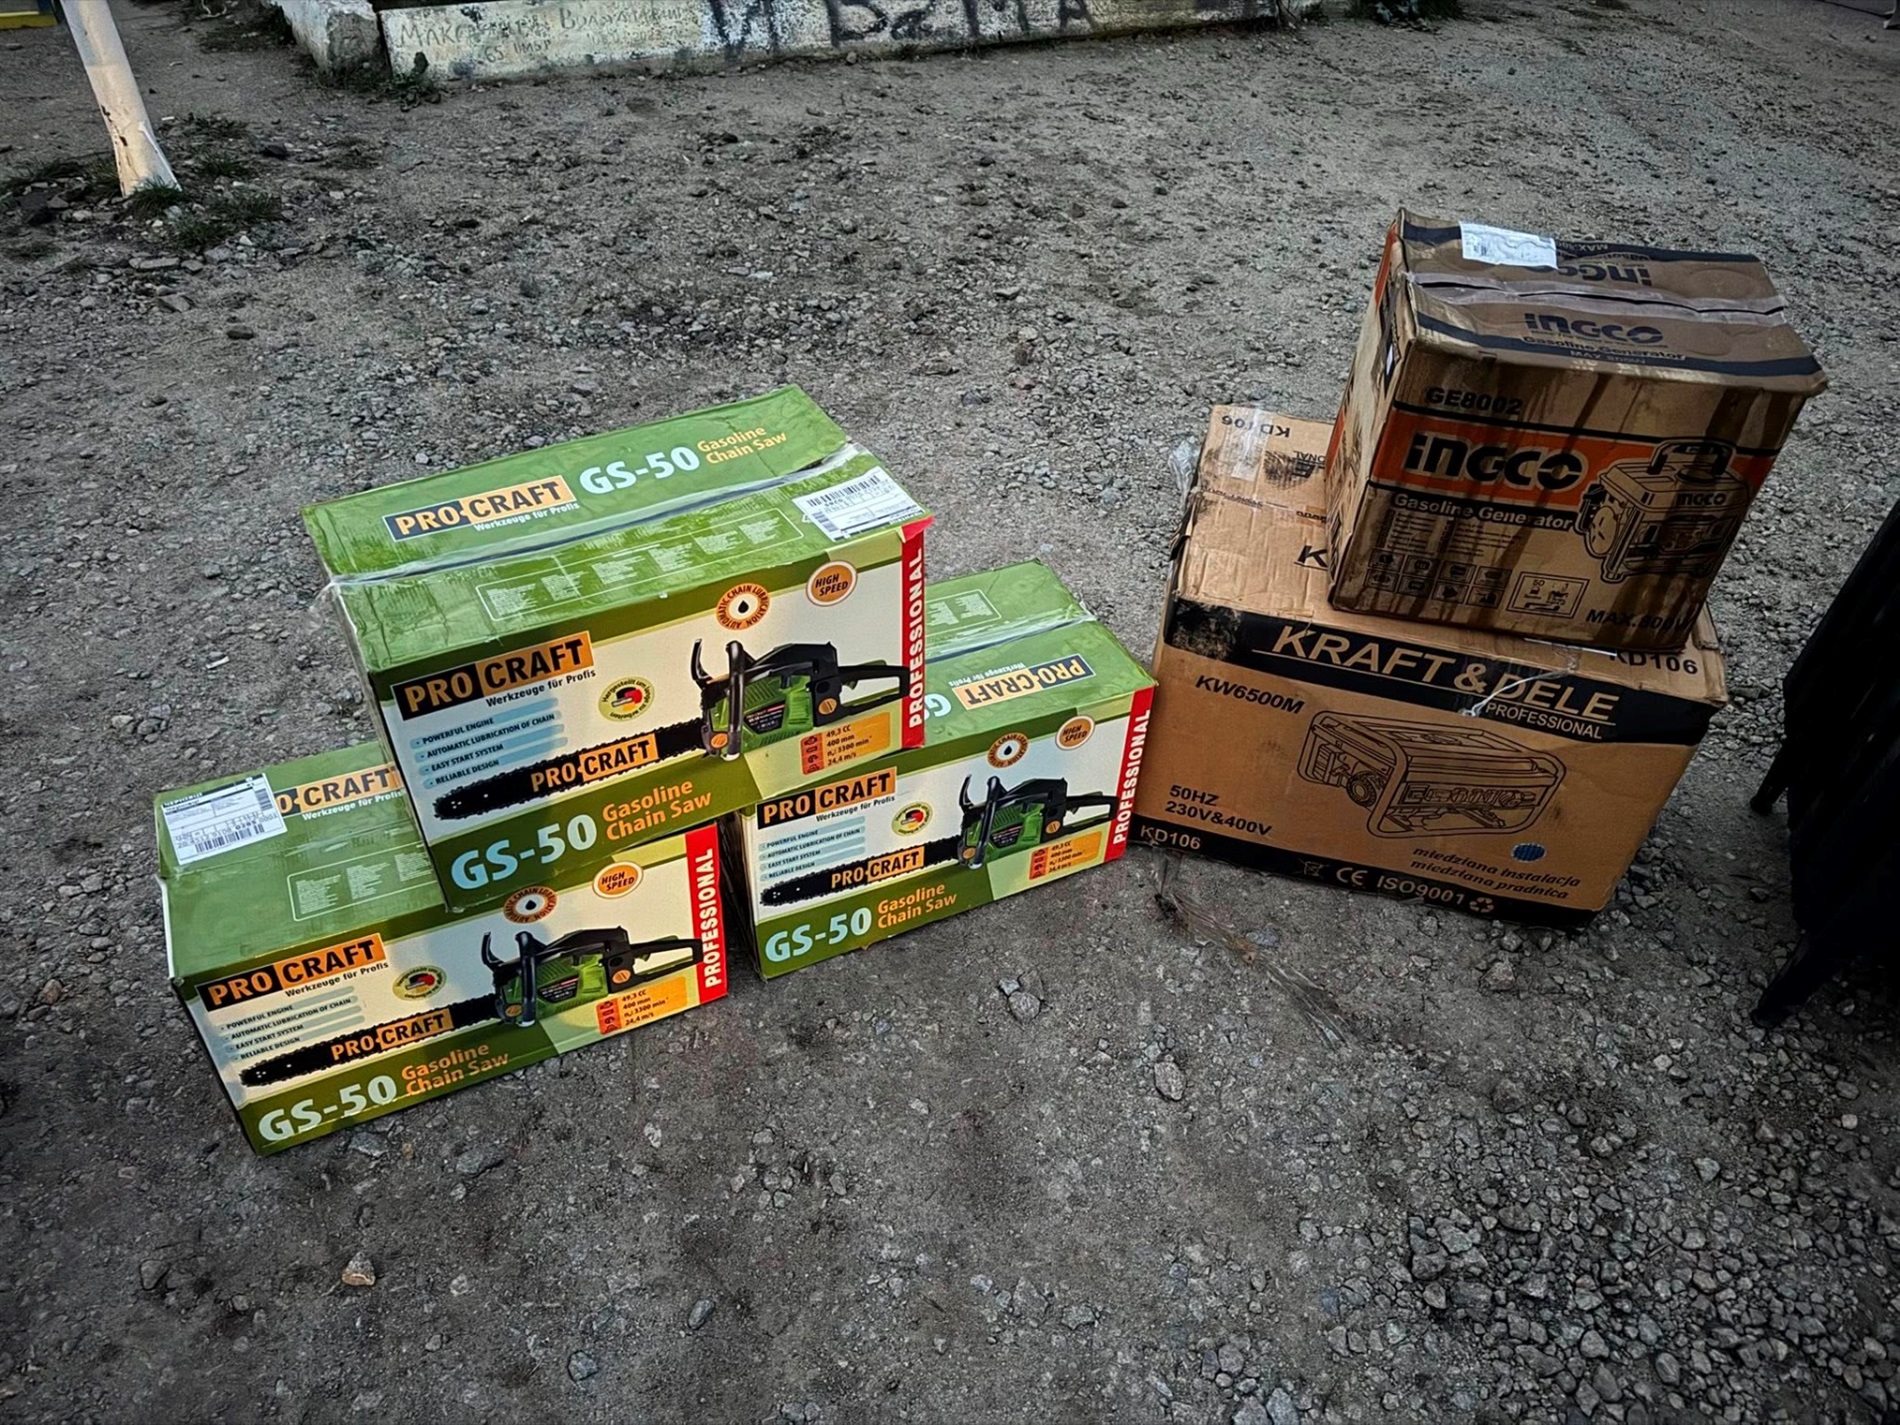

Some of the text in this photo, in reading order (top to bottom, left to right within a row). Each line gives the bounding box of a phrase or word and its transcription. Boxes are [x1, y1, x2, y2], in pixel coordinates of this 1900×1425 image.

[1426, 387, 1522, 416] GE8002
[697, 427, 767, 453] Gasoline
[1221, 415, 1290, 437] KD106
[706, 432, 787, 464] Chain Saw
[580, 447, 701, 495] GS-50
[474, 500, 580, 533] Werkzeuge für Profis
[1394, 493, 1573, 530] Gasoline Geneator
[815, 573, 837, 587] HIGH
[819, 581, 849, 597] SPEED
[908, 547, 922, 728] PROFESSIONAL
[485, 668, 597, 707] Werkzeuge für Profis
[1271, 625, 1620, 721] KRAFT & DELE
[1195, 675, 1305, 714] KW6500M
[422, 718, 494, 744] POWERFUL ENGINE
[426, 714, 555, 758] AUTOMATIC LUBRICATION OF CHAIN
[1063, 725, 1082, 737] HIGH
[1064, 730, 1088, 742] SPEED
[1485, 702, 1603, 740] PROFESSIONAL
[431, 744, 504, 772] EASY START SYSTEM
[435, 759, 499, 785] RELIABLE DESIGN
[1112, 709, 1150, 845] PROFESSIONAL
[302, 801, 356, 821] Werkzeuge
[358, 796, 372, 809] für
[602, 780, 693, 821] Gasoline
[815, 794, 896, 822] Werkzeuge für Profis
[1169, 784, 1219, 806] 50HZ
[606, 791, 712, 840] Chain Saw
[1165, 801, 1272, 836] 230V&400V
[451, 813, 598, 889] GS-50
[1140, 825, 1201, 850] KD106
[601, 870, 625, 885] HIGH
[607, 875, 635, 892] SPEED
[1376, 875, 1464, 905] ISO9001
[1499, 867, 1580, 887] instalacja
[877, 883, 945, 915] Gasoline
[877, 893, 957, 929] Chain Saw
[694, 848, 721, 988] PROFESSIONAL
[765, 906, 873, 962] GS-50
[285, 961, 389, 998] Werkzeuge für Profis
[226, 1005, 293, 1030] POWERFUL ENGINE
[231, 1022, 272, 1040] AUTOMATIC
[272, 1008, 318, 1026] LUBRICATION
[329, 998, 351, 1009] CHAIN
[236, 1024, 304, 1050] EASY START SYSTEM
[240, 1036, 300, 1060] RELIABLE DESIGN
[401, 1044, 489, 1080] Gasoline
[405, 1053, 509, 1096] Chain Saw
[258, 1075, 397, 1141] GS-50
